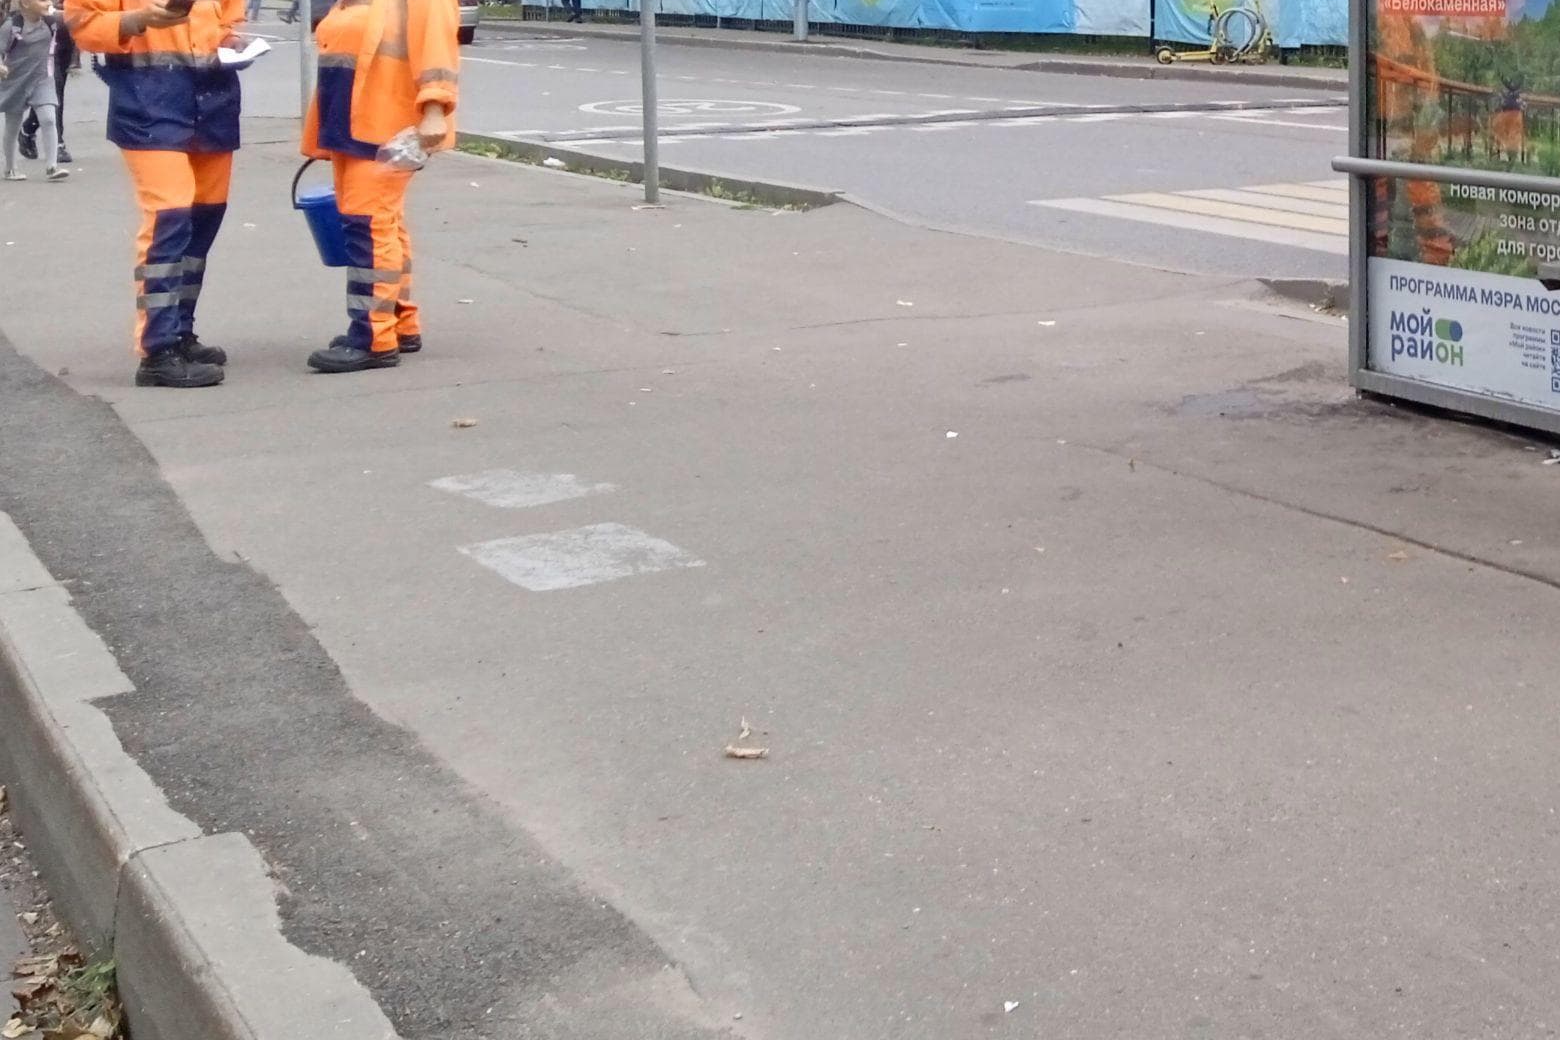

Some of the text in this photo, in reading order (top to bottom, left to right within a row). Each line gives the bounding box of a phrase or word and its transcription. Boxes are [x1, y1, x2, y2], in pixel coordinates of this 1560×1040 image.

[1499, 213, 1536, 232] зона
[1496, 239, 1526, 256] для
[1389, 274, 1478, 305] ПРОГРАММА
[1480, 288, 1524, 312] МЭРА
